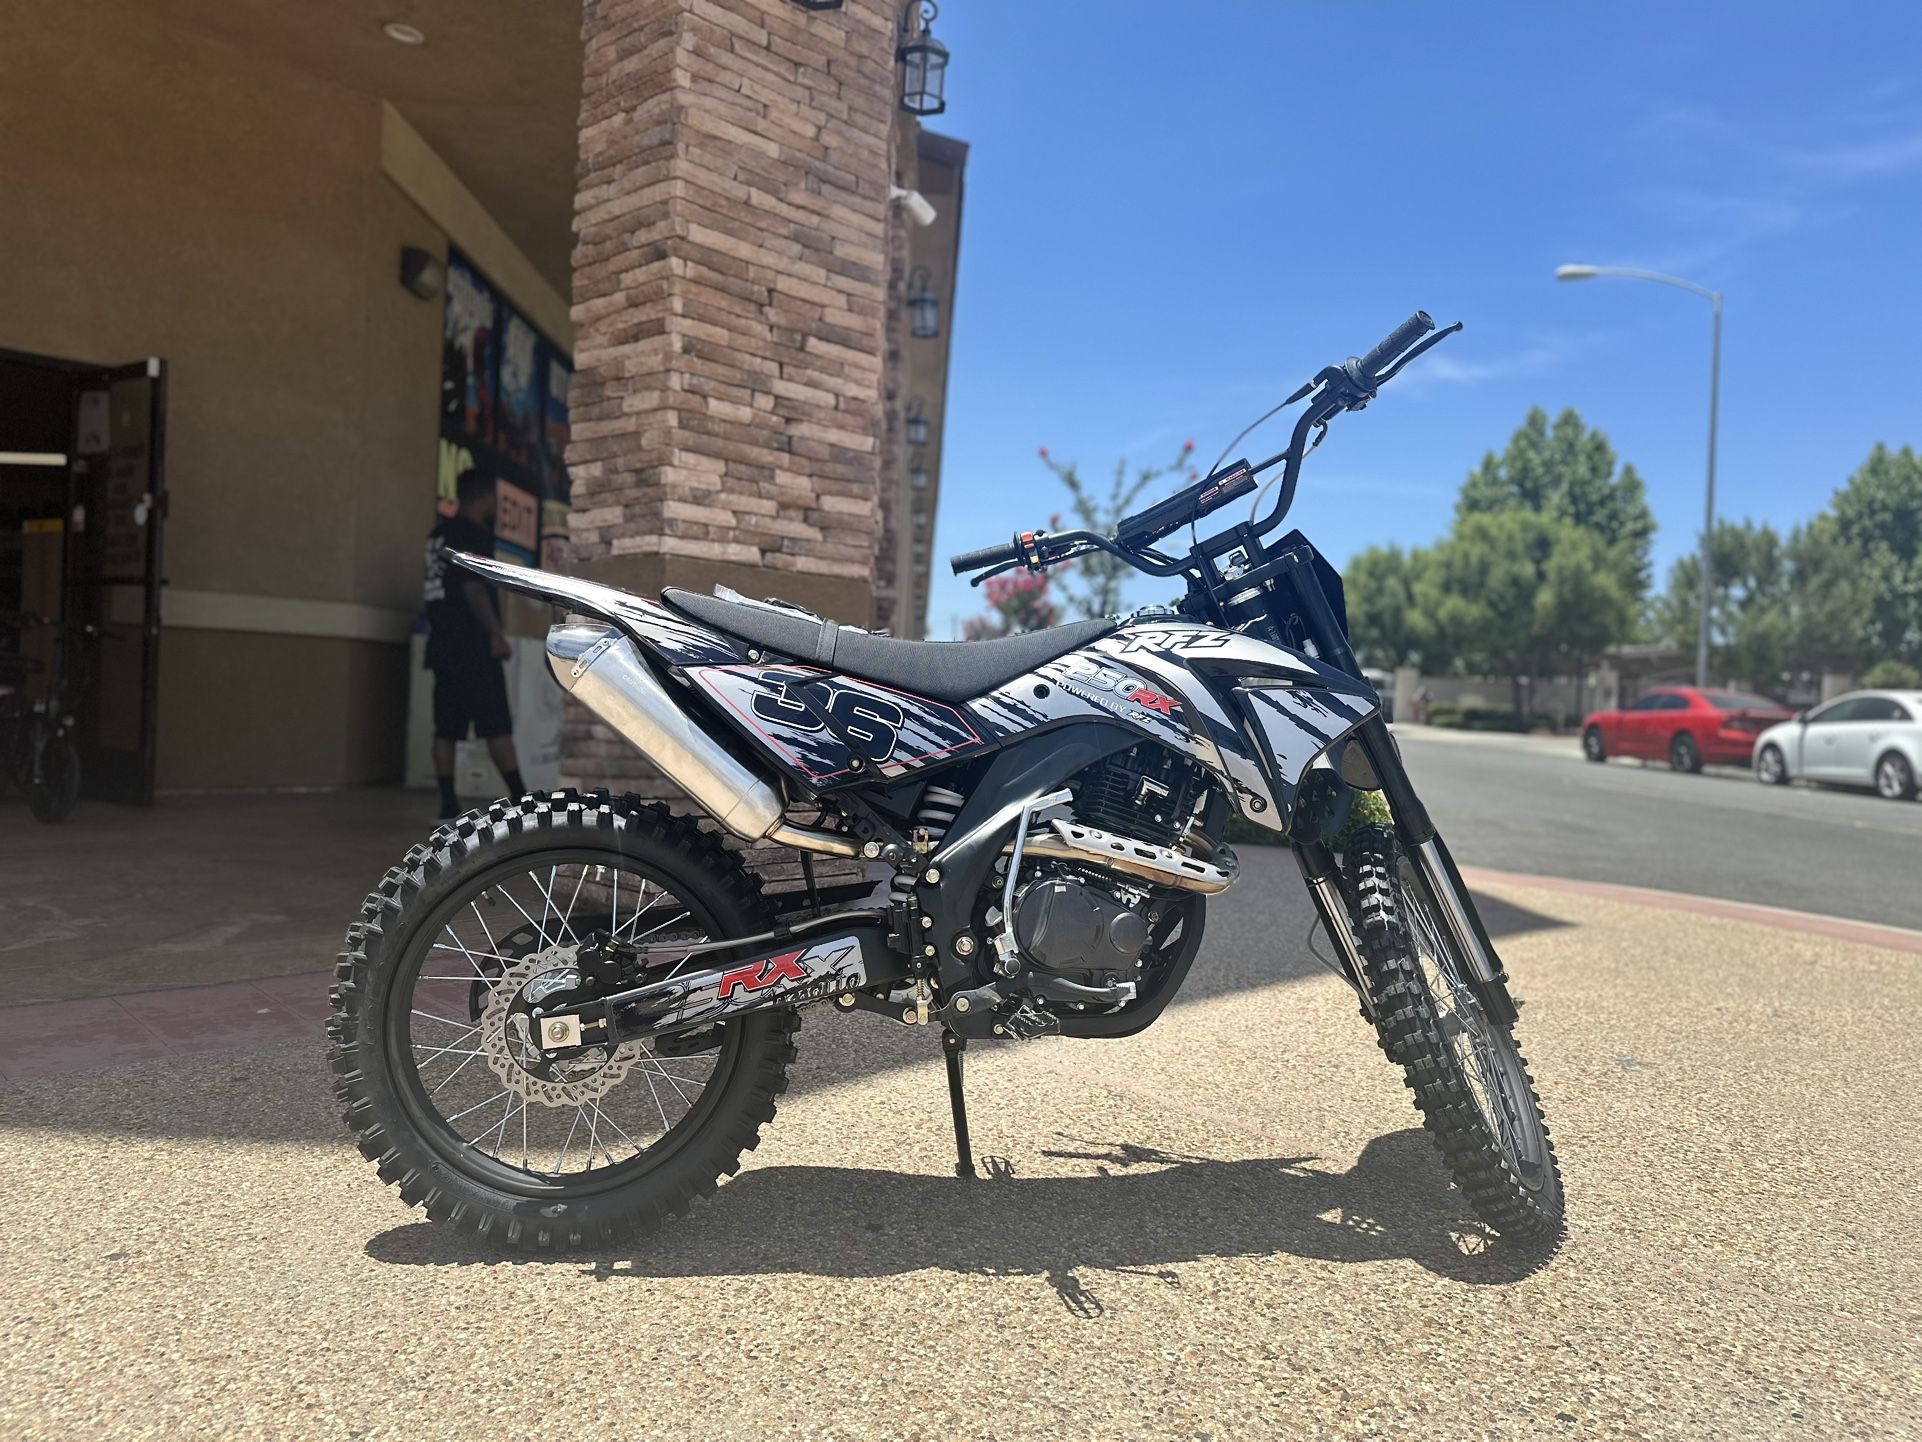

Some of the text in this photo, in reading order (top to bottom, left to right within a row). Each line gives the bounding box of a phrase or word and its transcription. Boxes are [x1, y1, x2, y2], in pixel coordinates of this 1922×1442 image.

[1120, 630, 1233, 654] RFZ
[1055, 680, 1152, 724] POWERED BY RFZ
[717, 947, 808, 1000] RX
